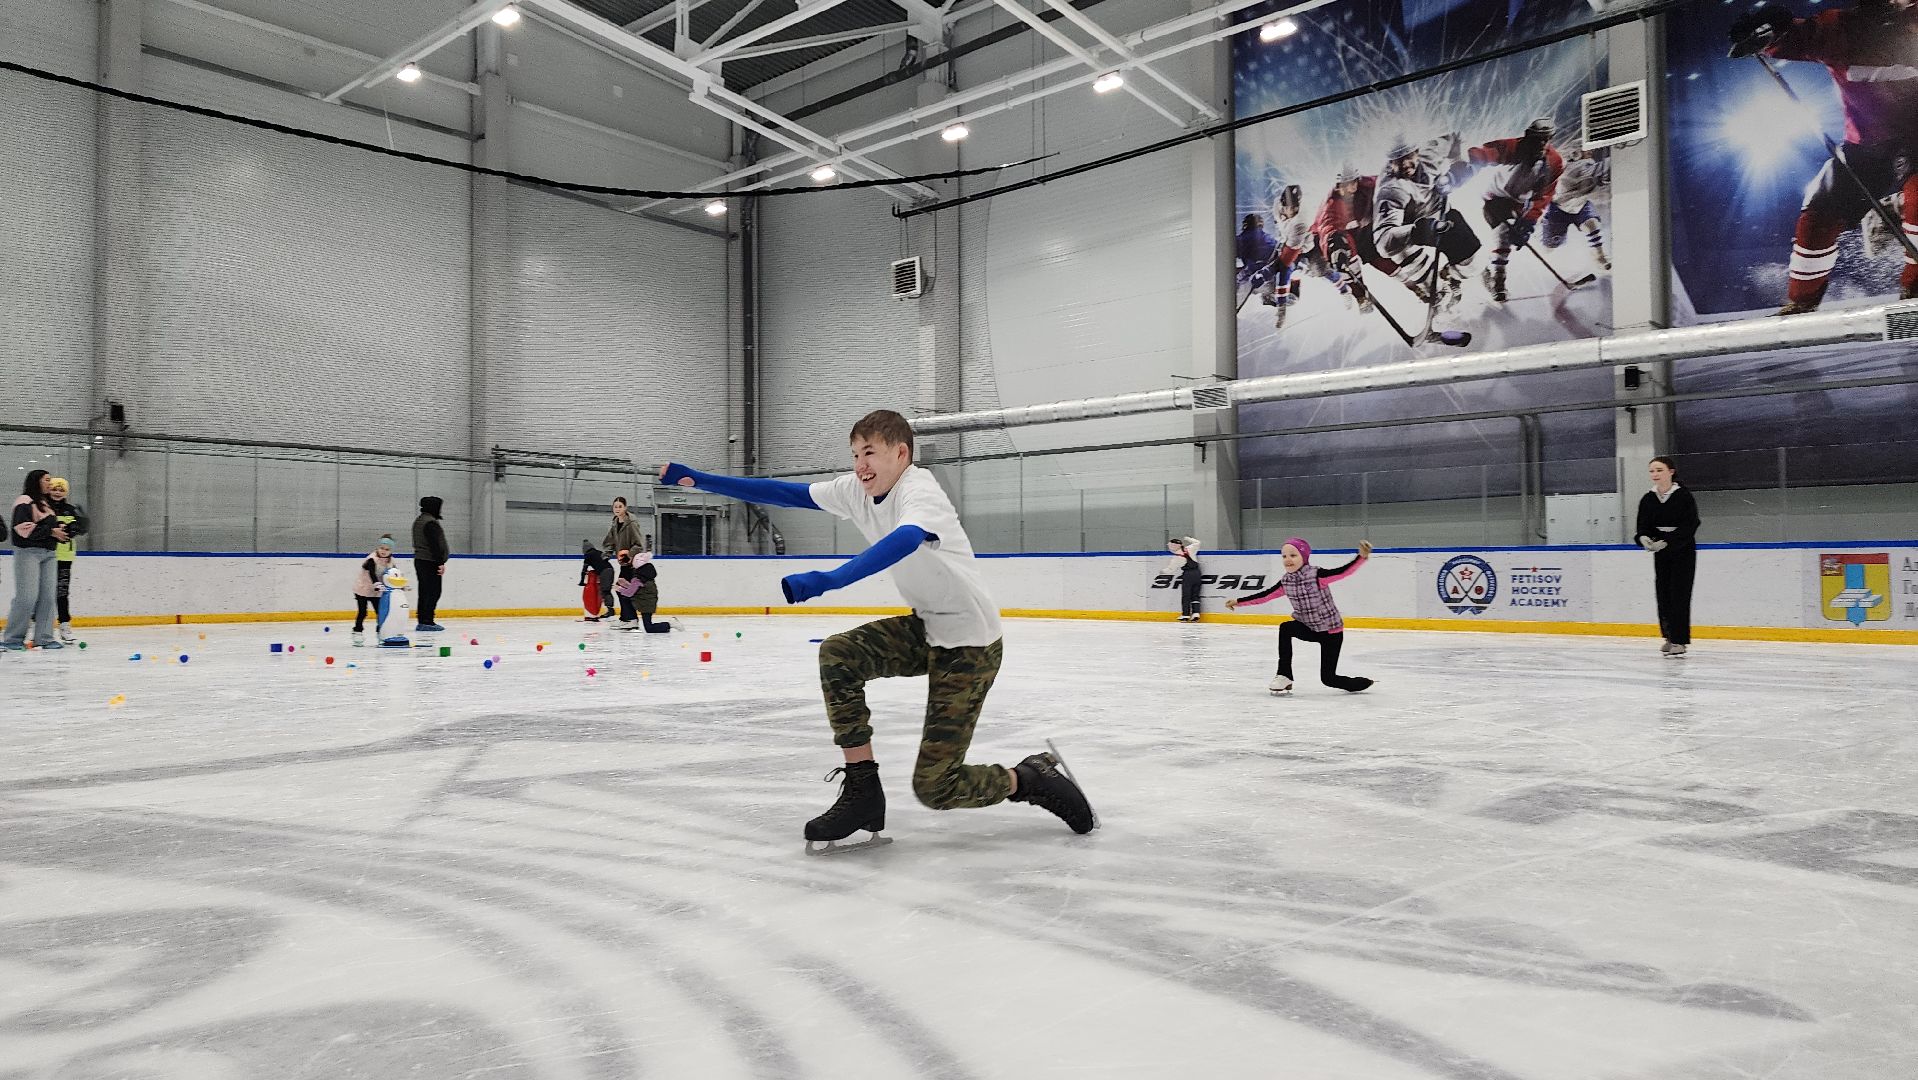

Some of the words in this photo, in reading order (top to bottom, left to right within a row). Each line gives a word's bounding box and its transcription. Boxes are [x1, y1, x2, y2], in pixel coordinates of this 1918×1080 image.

[1511, 574, 1562, 583] FETISOV
[1511, 586, 1562, 595] HOCKEY
[1509, 598, 1568, 607] ACADEMY
